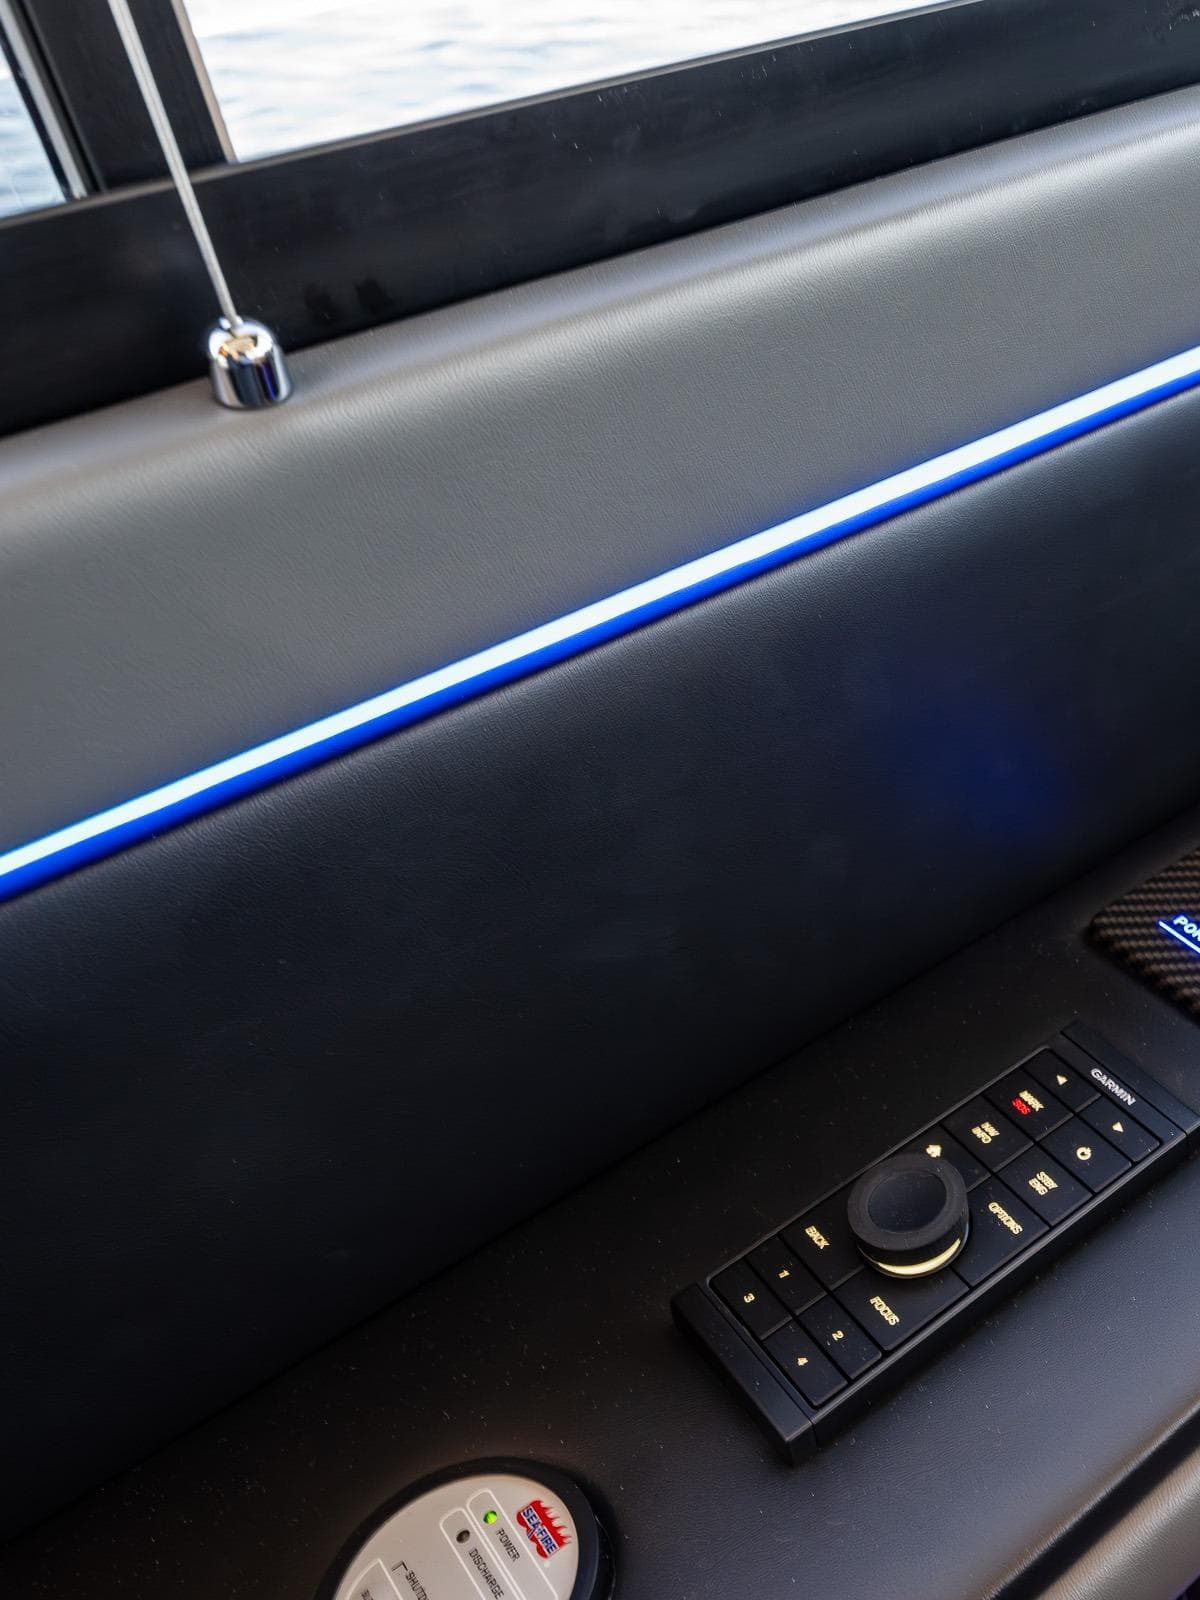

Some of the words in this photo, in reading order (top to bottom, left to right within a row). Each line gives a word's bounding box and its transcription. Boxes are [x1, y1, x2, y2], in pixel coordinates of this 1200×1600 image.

[1090, 1067, 1137, 1106] GARMIN
[1012, 1098, 1031, 1116] SOS
[988, 1201, 1023, 1235] OPTIONS
[805, 1225, 830, 1250] BACK
[778, 1269, 790, 1279] 1
[743, 1292, 755, 1304] 3
[869, 1296, 900, 1326] FOCUS
[831, 1329, 844, 1342] 2
[796, 1356, 809, 1367] 4
[496, 1527, 520, 1562] POWER
[468, 1547, 505, 1600] DISCHARGE
